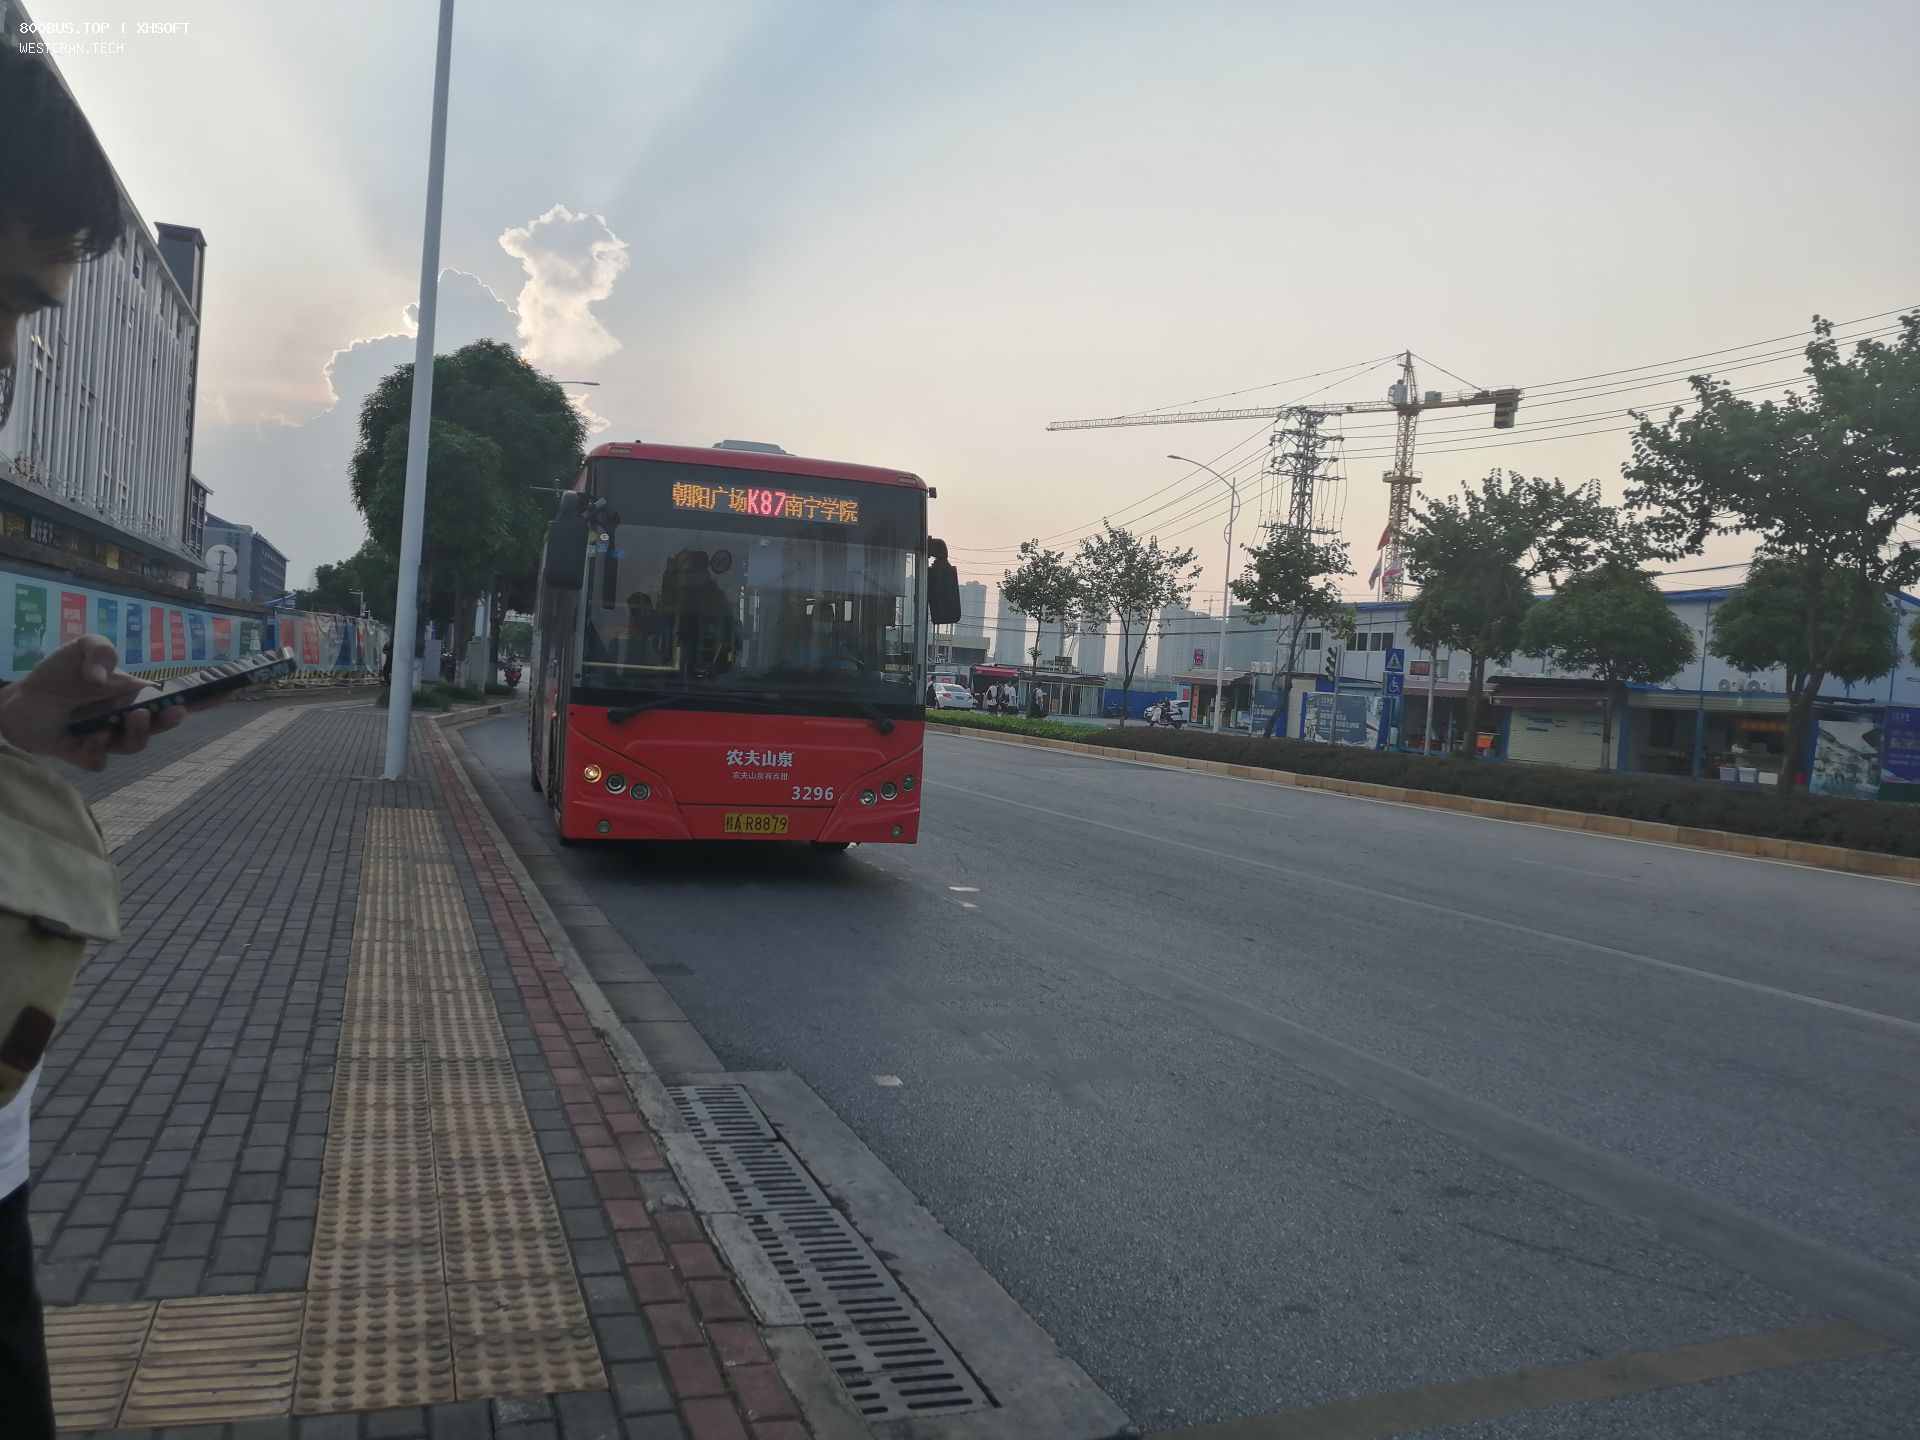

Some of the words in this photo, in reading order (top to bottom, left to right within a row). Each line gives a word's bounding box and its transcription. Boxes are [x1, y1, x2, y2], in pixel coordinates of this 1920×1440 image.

[726, 749, 793, 767] 农夫山泉
[791, 785, 834, 801] 3296
